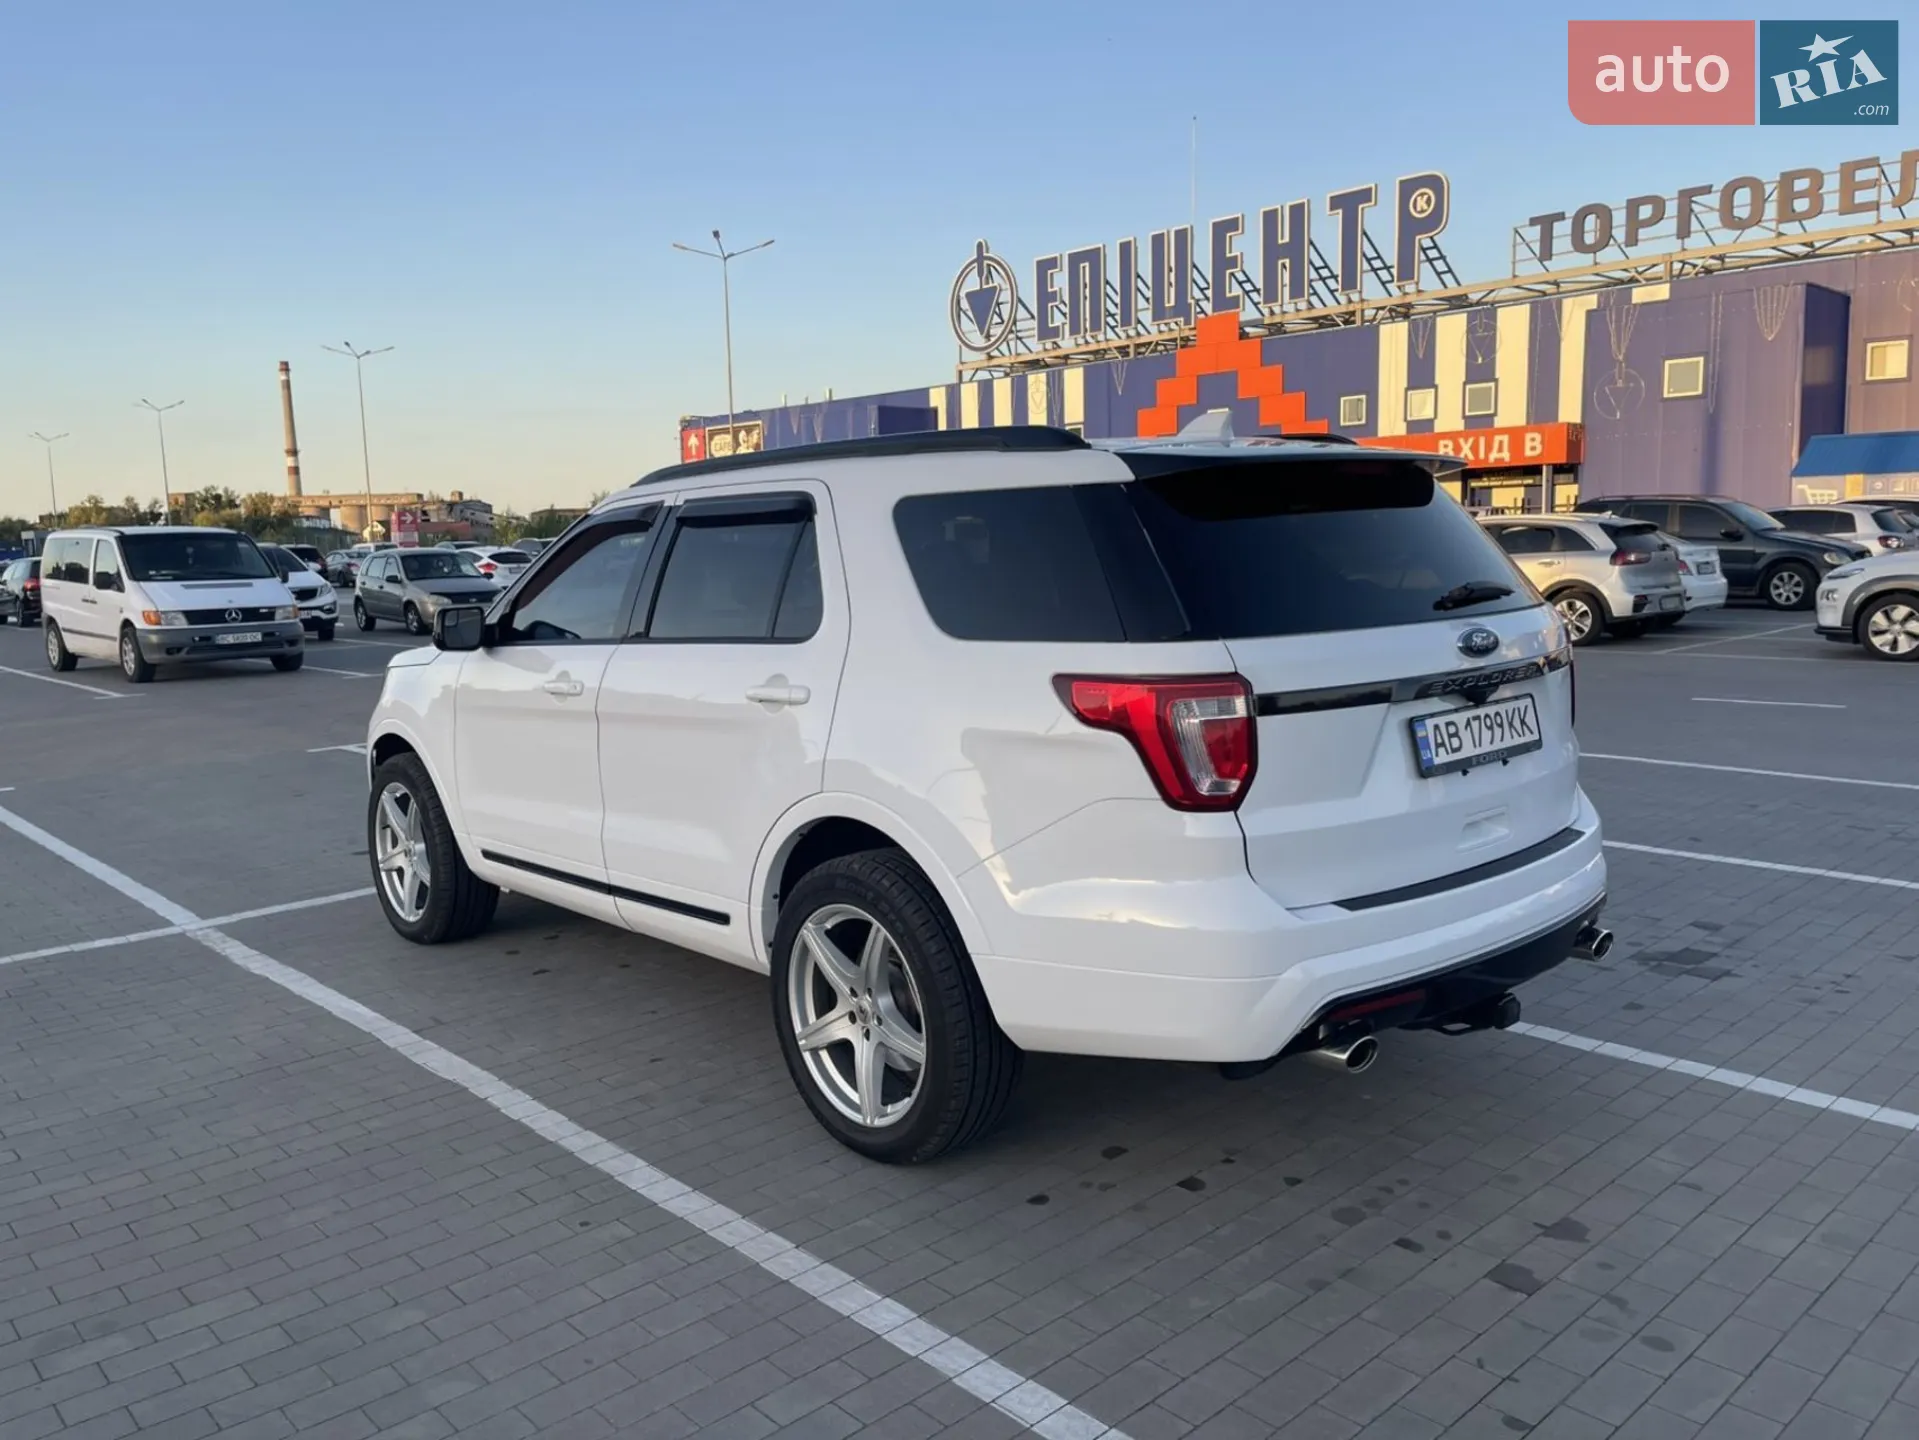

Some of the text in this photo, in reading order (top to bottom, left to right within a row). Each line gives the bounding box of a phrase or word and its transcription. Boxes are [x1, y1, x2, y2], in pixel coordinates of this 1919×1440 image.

[1034, 171, 1450, 343] ЕПІЦЕНТР
[1438, 432, 1543, 464] ВХІД В
[1428, 665, 1539, 695] EXPLORER
[1433, 704, 1535, 758] AB 1799 KK
